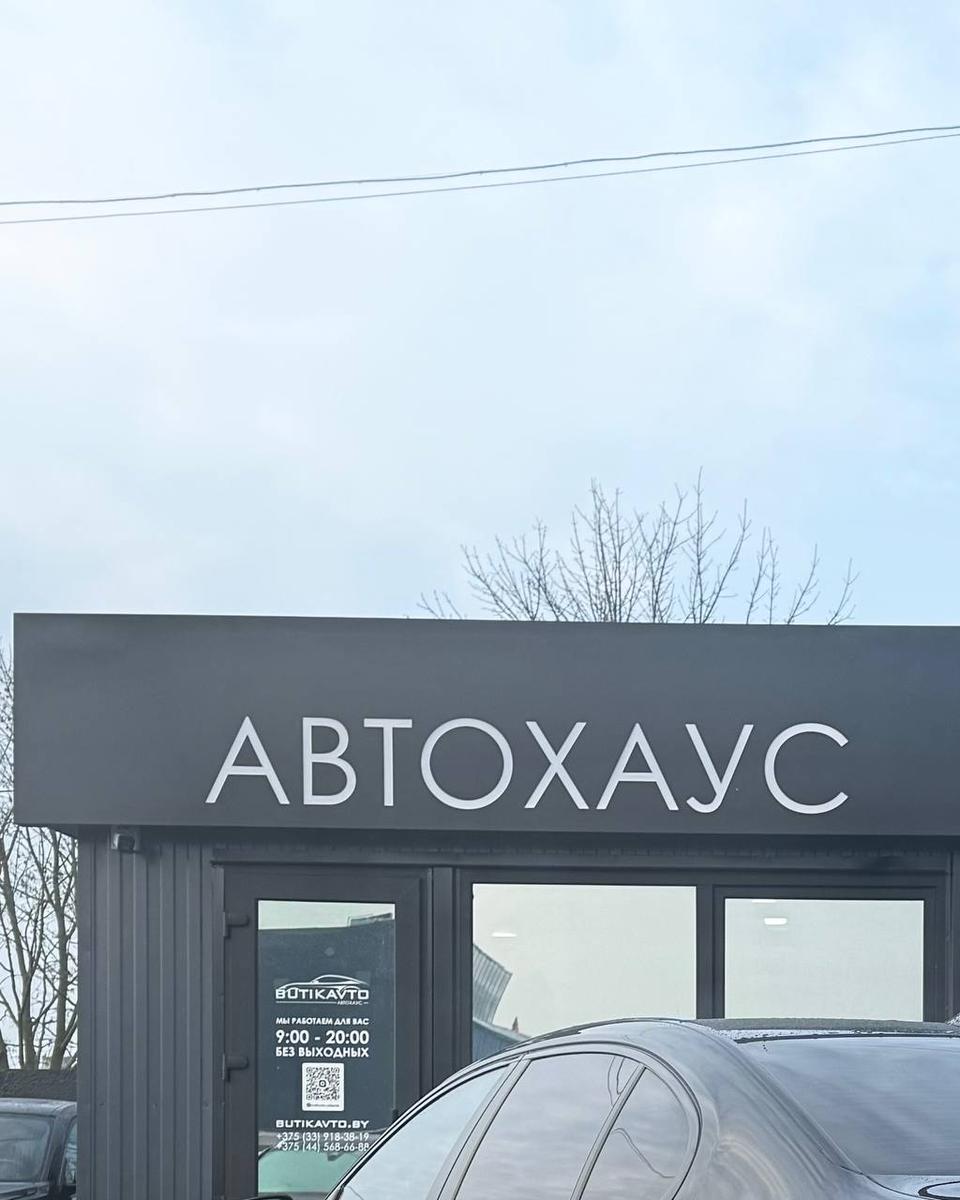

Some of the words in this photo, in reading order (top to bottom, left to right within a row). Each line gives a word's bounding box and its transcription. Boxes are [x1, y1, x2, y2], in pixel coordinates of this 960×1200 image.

[205, 715, 849, 815] АВТОХАУС
[275, 988, 369, 1000] BUTIKAVTO
[275, 1017, 290, 1025] МЫ
[291, 1017, 333, 1025] РАБОТАЕМ
[334, 1018, 351, 1026] ДЛЯ
[352, 1018, 370, 1026] ВАС
[275, 1029, 310, 1044] 9:00
[325, 1030, 370, 1045] 20:00
[275, 1046, 296, 1057] БЕЗ
[298, 1046, 370, 1059] ВЫХОДНЫХ
[275, 1119, 370, 1129] BUTIKAVTO.BY
[276, 1132, 300, 1141] +375
[302, 1131, 321, 1144] (33)
[323, 1132, 370, 1142] 918-38-19
[275, 1142, 300, 1151] +375
[302, 1141, 321, 1153] (44)
